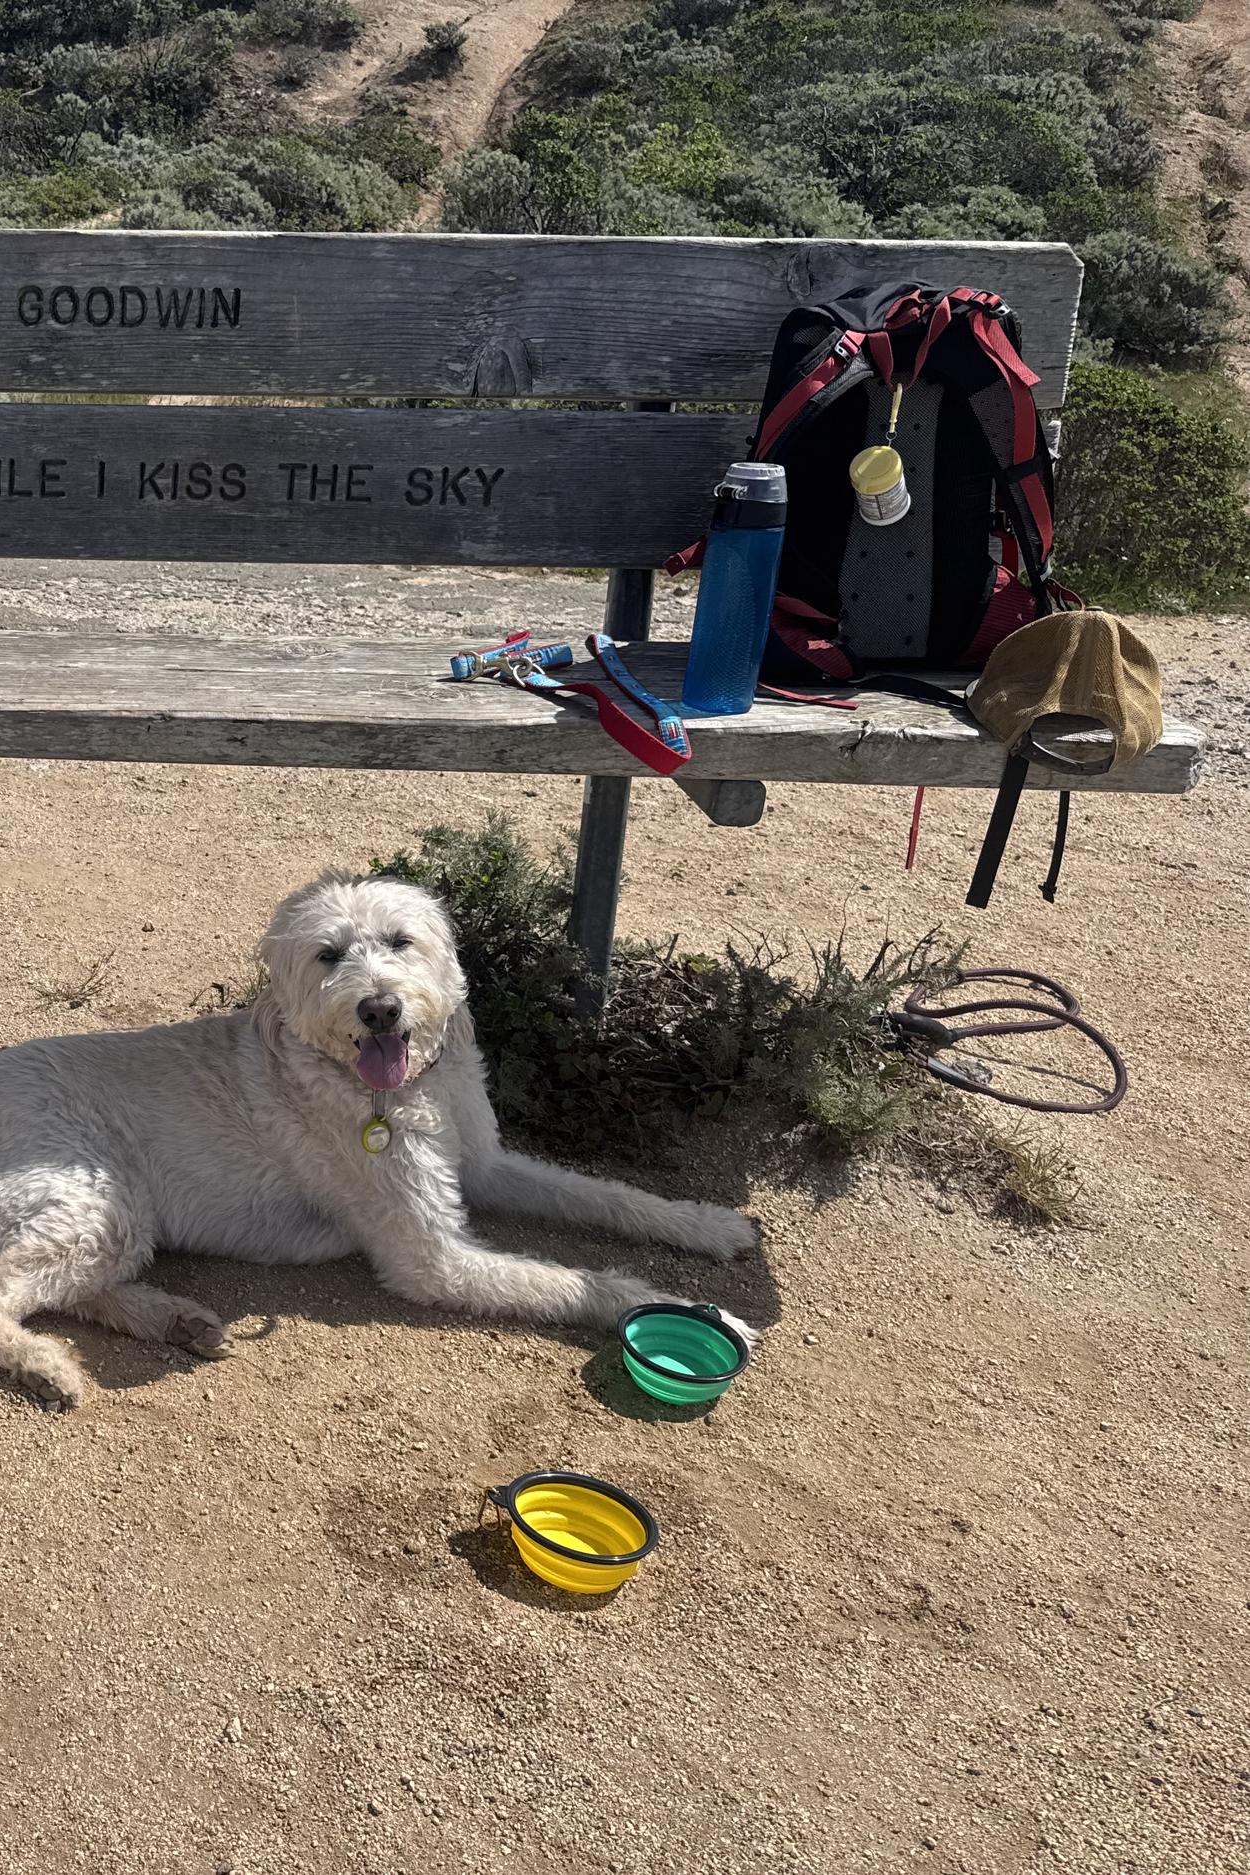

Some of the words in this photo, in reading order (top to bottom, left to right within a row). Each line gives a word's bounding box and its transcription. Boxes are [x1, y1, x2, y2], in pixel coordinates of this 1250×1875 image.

[16, 284, 243, 330] GOODWIN
[96, 461, 107, 499] I
[137, 461, 248, 502] KISS
[278, 462, 375, 503] THE
[404, 466, 506, 507] SKY
